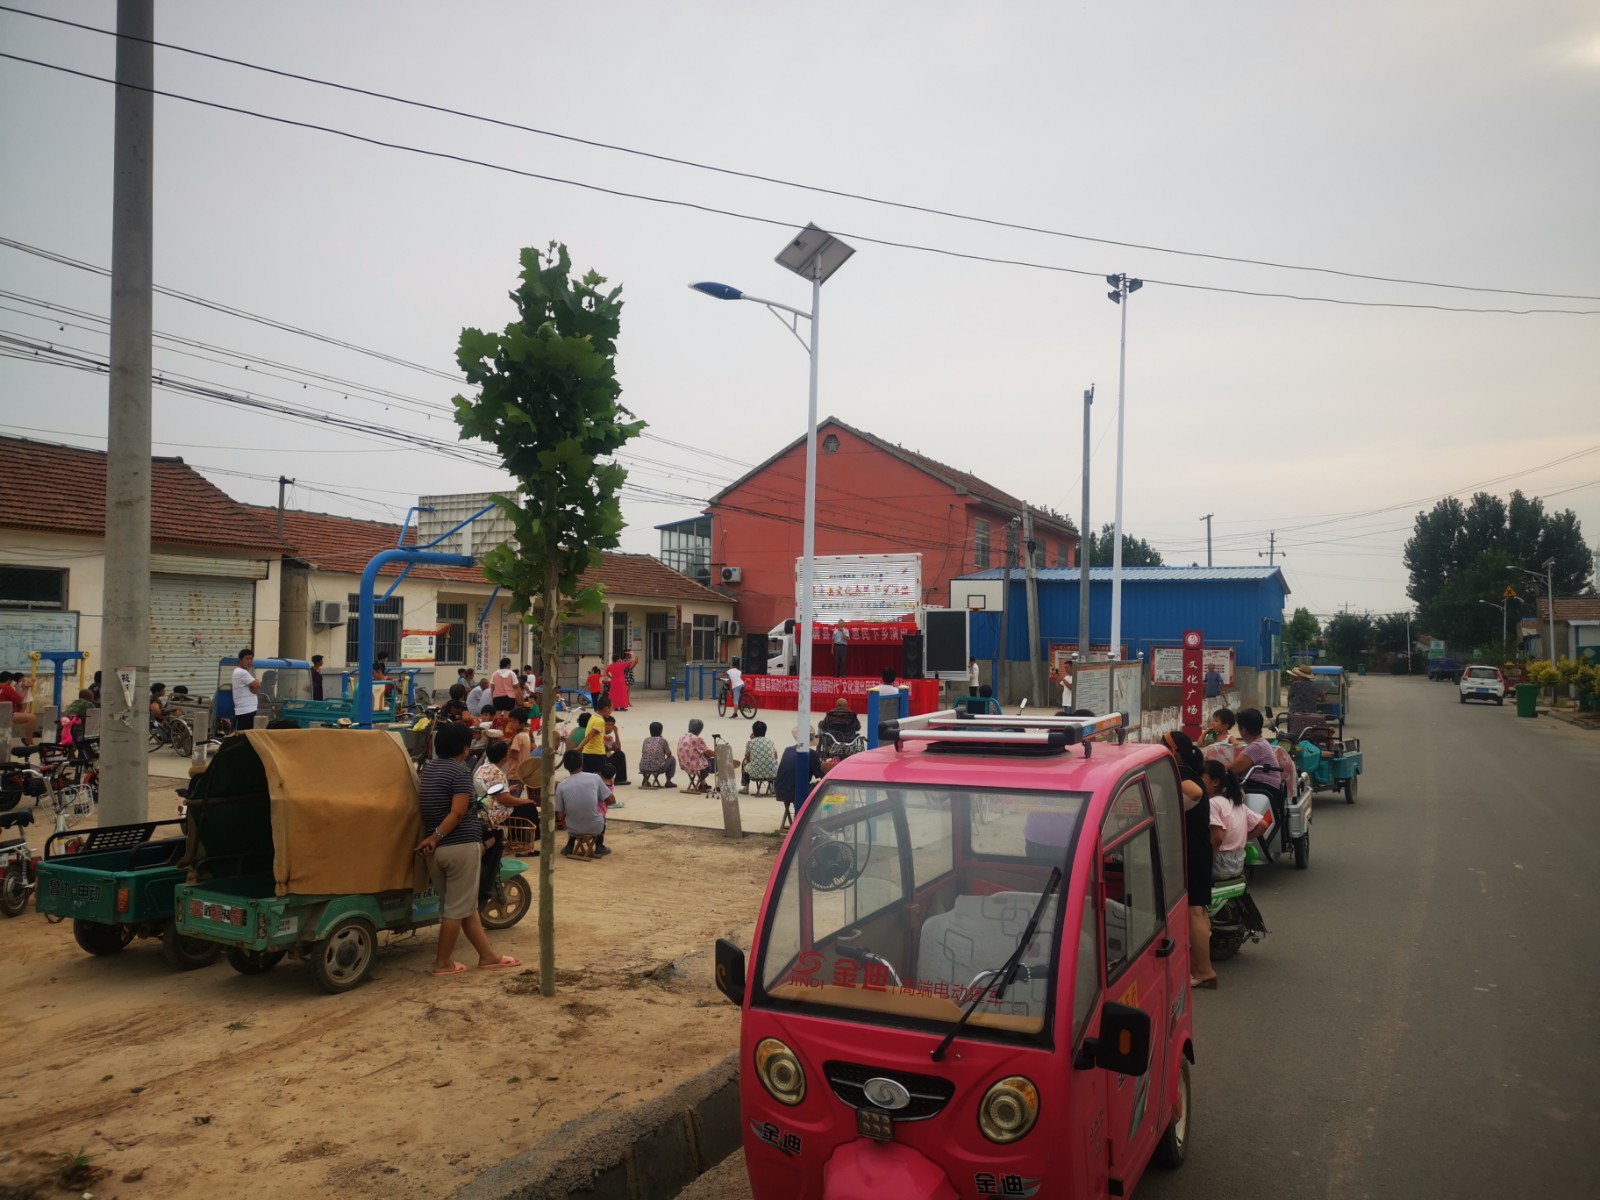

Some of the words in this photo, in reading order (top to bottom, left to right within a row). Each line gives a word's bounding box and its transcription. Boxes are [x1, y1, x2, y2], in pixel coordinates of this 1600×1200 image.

[1186, 659, 1199, 716] 文化广场
[787, 975, 825, 990] JINDI
[832, 958, 890, 992] 金迪
[762, 1121, 802, 1156] 金迪
[974, 1172, 1025, 1196] 金迪
